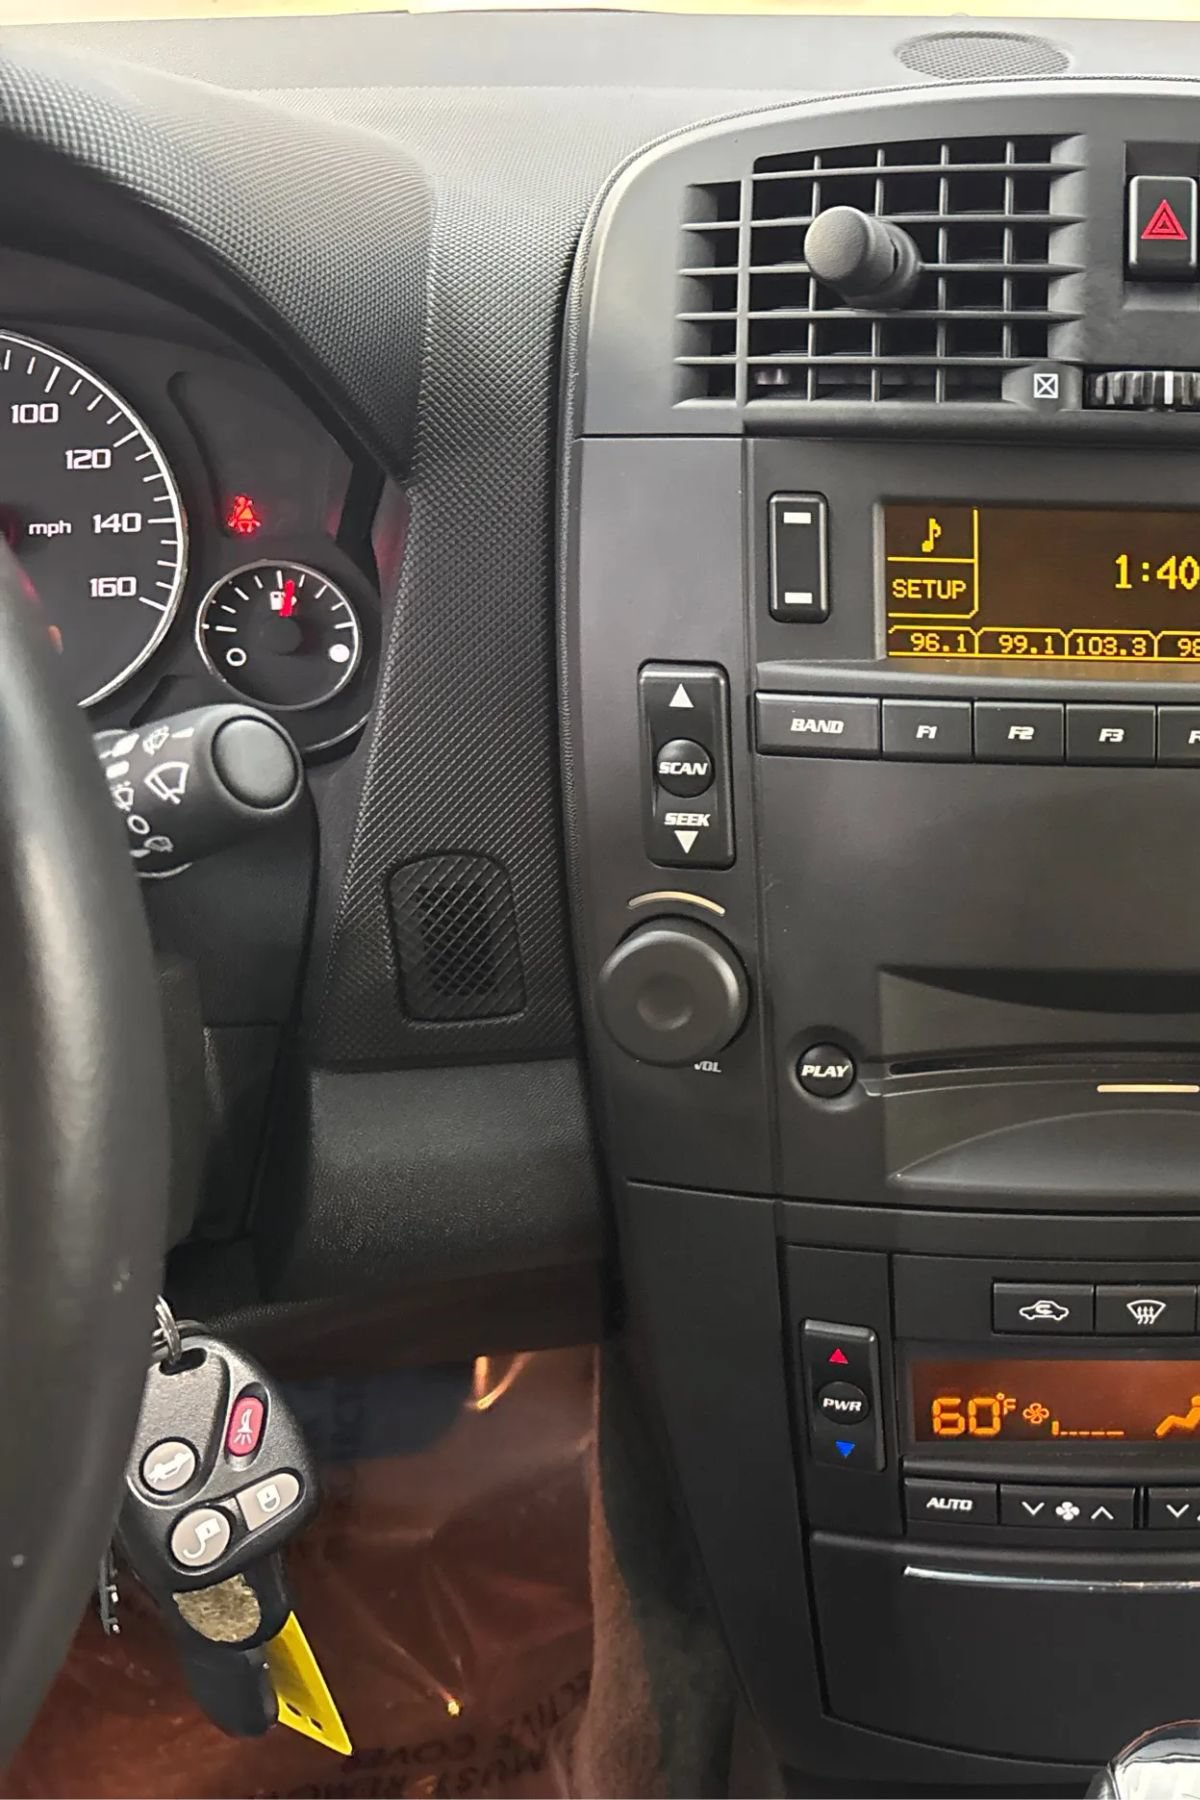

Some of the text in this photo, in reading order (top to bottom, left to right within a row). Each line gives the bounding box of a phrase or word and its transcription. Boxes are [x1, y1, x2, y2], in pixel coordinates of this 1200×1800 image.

[11, 403, 59, 424] 100
[65, 448, 112, 470] 120
[28, 520, 72, 537] mph
[92, 512, 142, 534] 140
[1115, 554, 1200, 590] 1:40
[89, 576, 137, 598] 160
[892, 578, 967, 600] SETUP
[909, 632, 968, 653] 96.1
[998, 634, 1056, 655] 99.1
[1075, 636, 1148, 656] 103.3
[790, 718, 845, 734] BAND
[916, 725, 938, 739] F1
[1007, 725, 1035, 740] F2
[1098, 728, 1125, 743] F3
[658, 761, 708, 776] SCAN
[664, 812, 711, 827] SEEK
[801, 1064, 849, 1078] PLAY
[823, 1397, 862, 1412] PWR
[926, 1497, 973, 1511] AUTO
